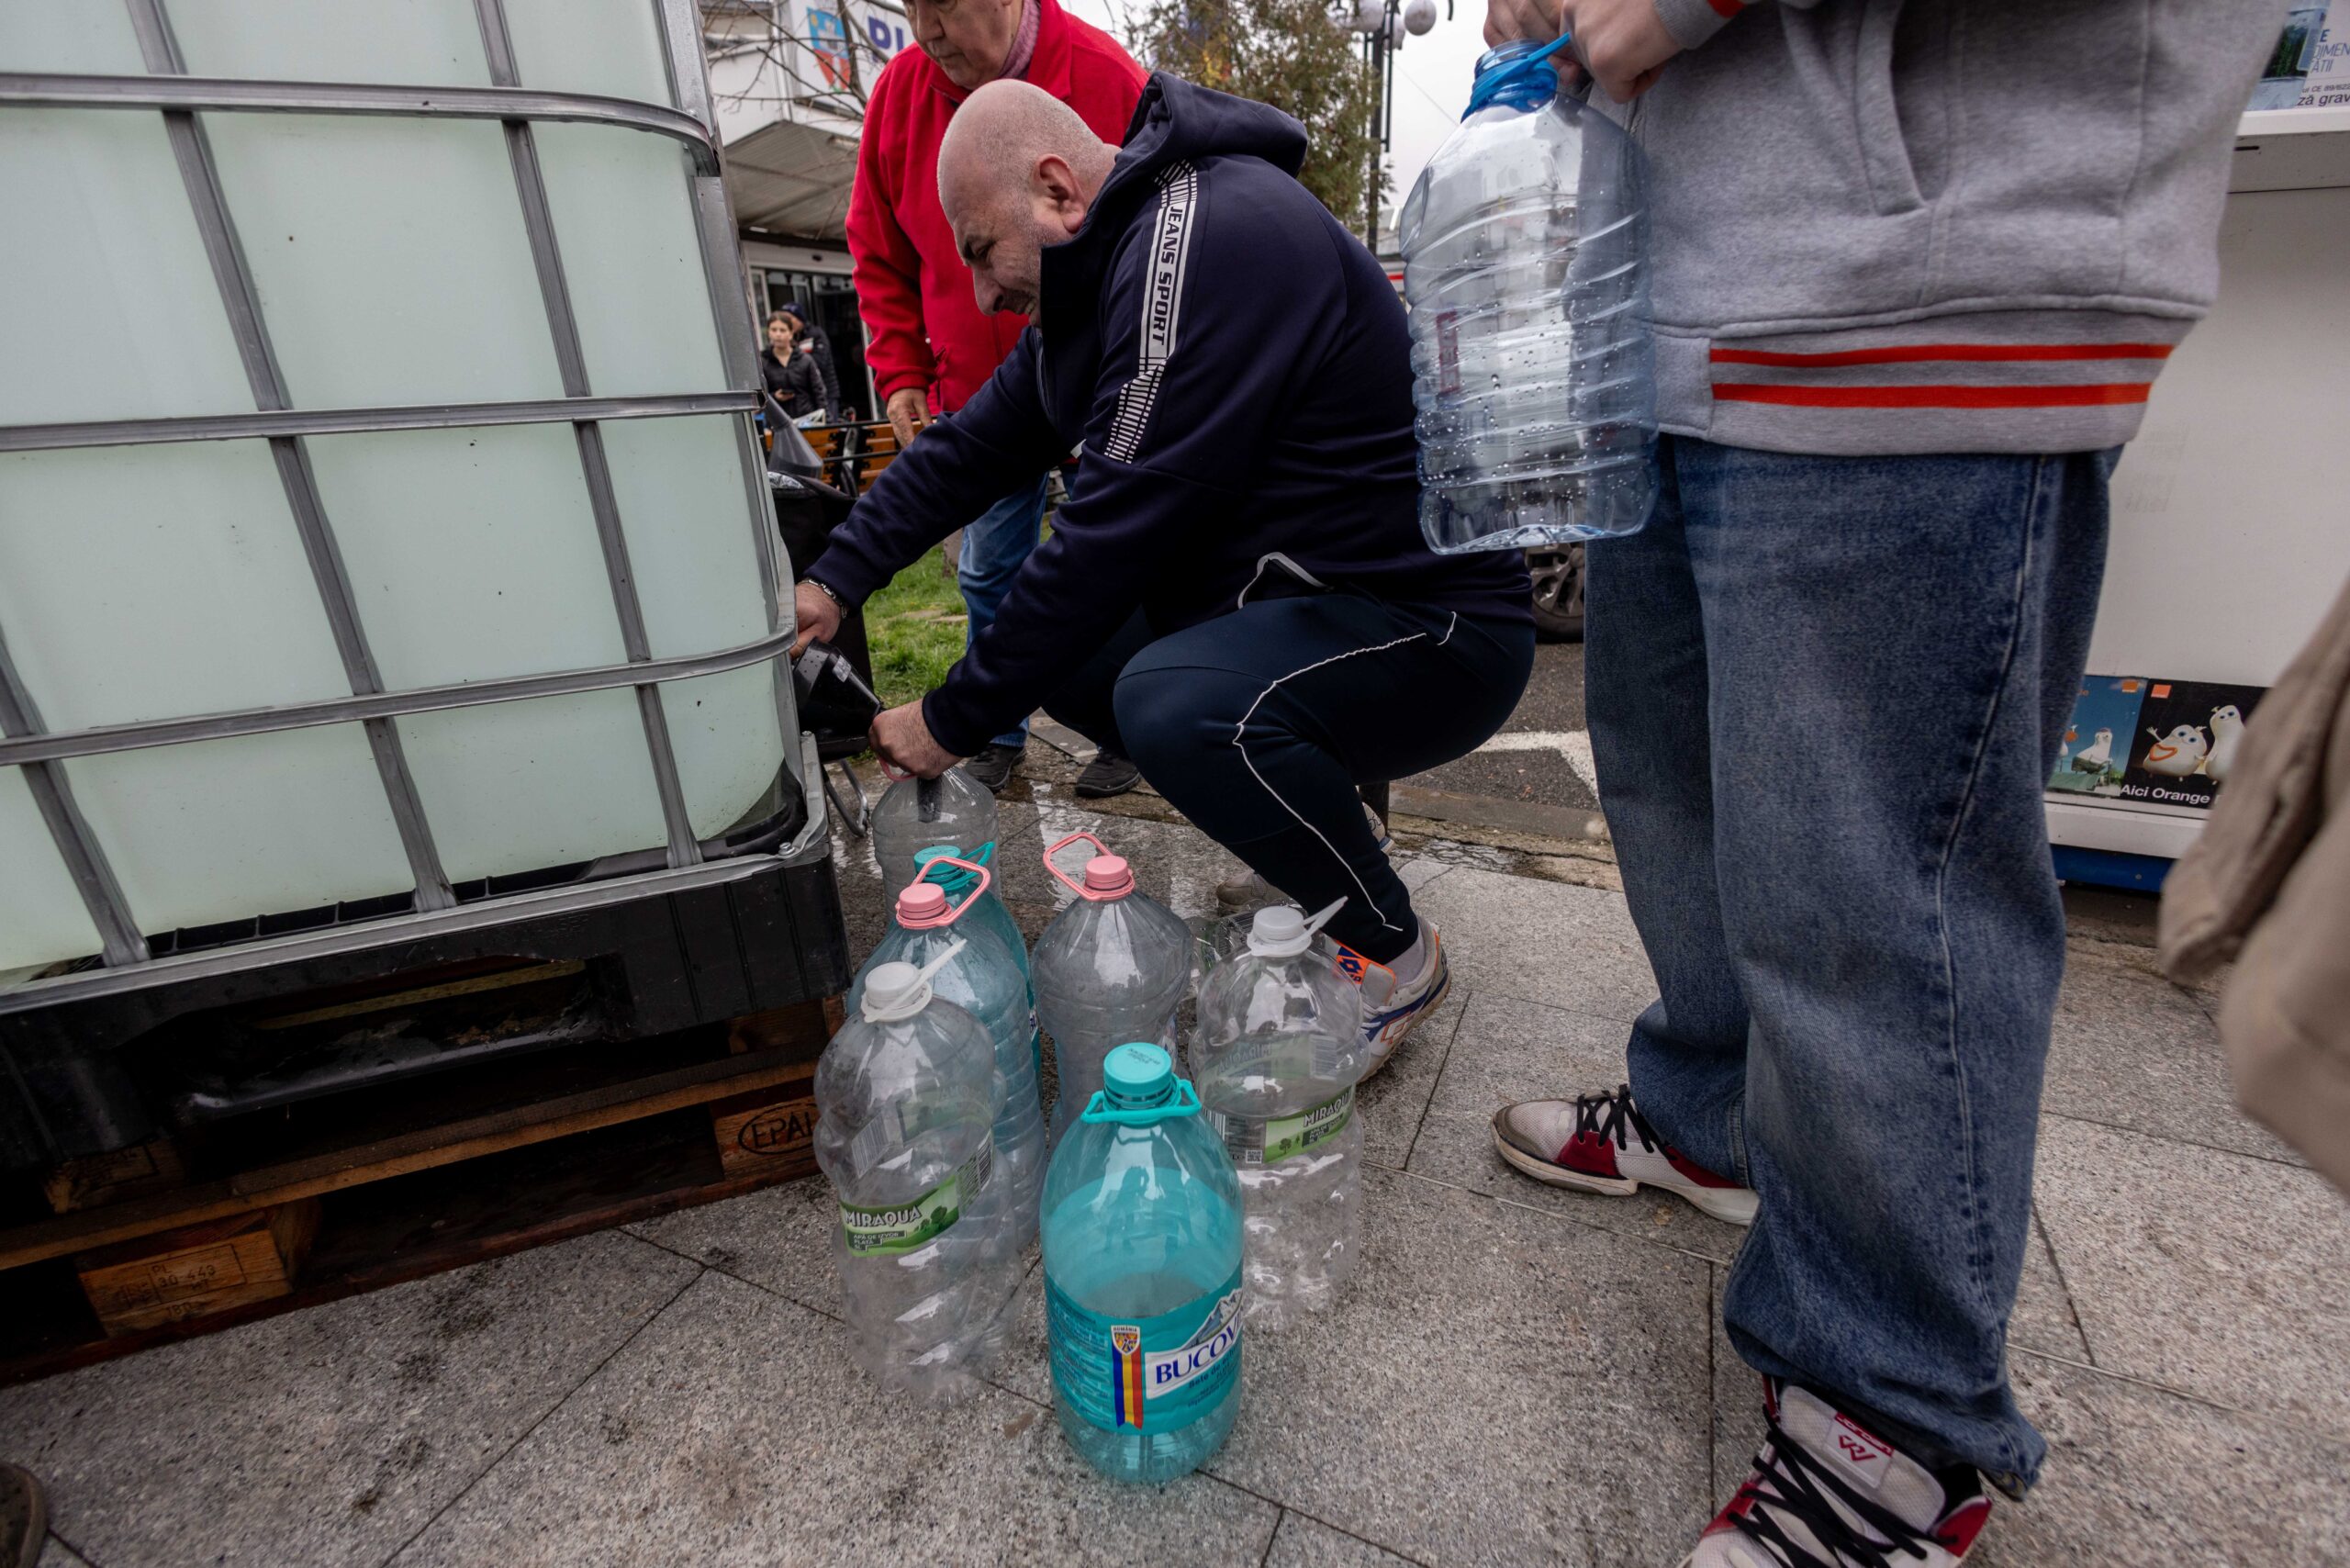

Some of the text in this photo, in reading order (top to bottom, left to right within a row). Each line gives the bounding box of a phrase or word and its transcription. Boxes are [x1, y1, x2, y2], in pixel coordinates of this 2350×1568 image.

[1152, 205, 1183, 346] JEANS SPORT
[2121, 783, 2211, 805] Aici Orange
[844, 1205, 923, 1226] MIRAQUA
